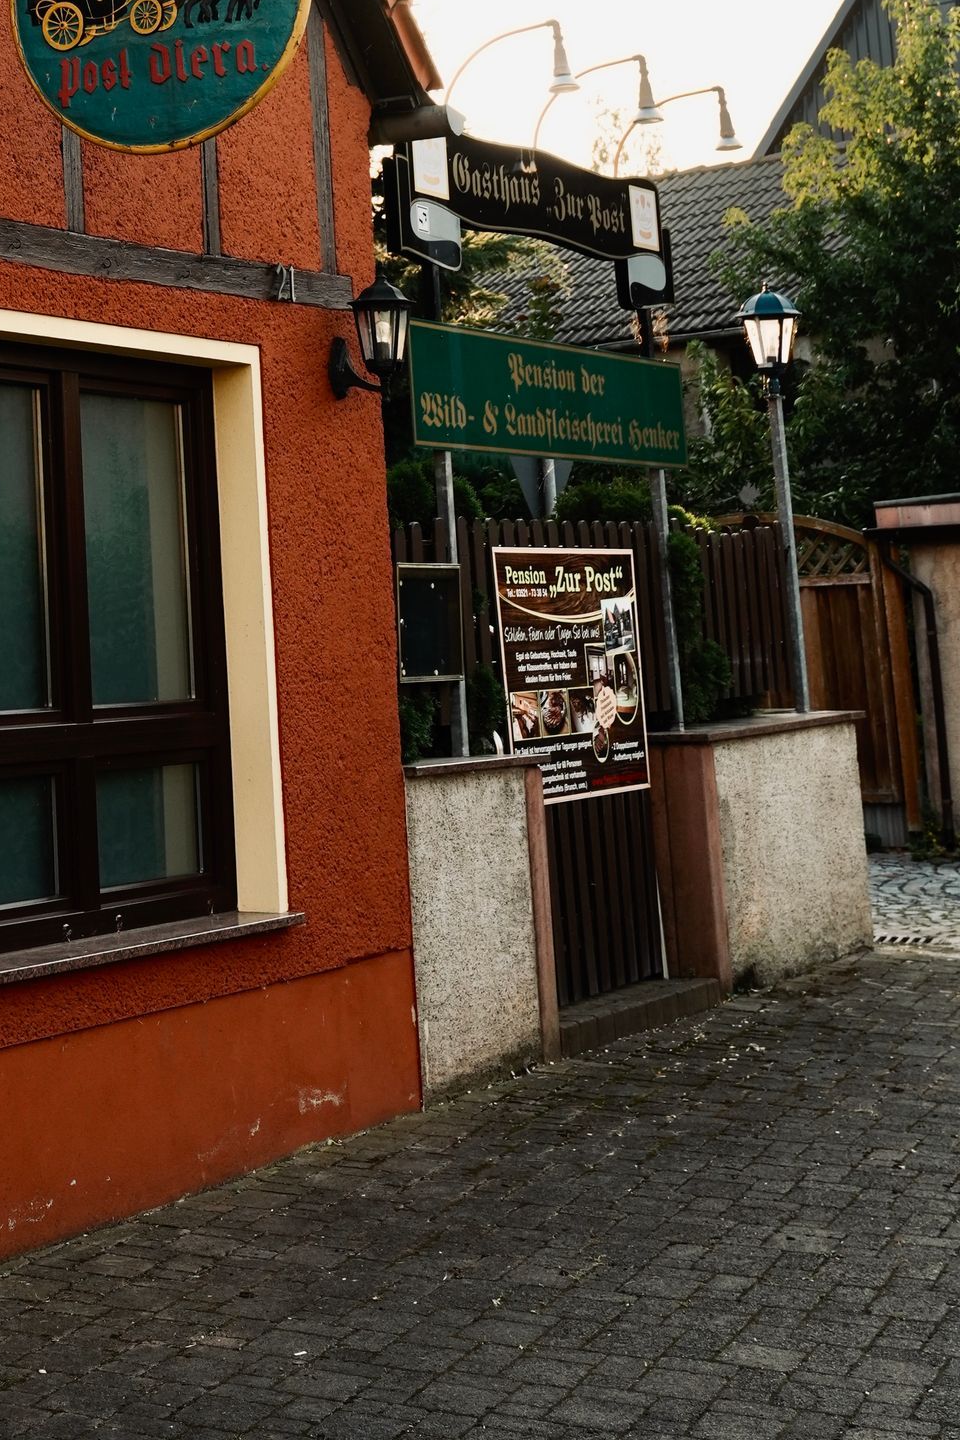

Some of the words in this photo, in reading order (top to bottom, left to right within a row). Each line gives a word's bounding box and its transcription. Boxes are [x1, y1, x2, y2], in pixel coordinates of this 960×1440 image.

[452, 152, 540, 213] Gasthaus
[276, 262, 297, 302] 21
[507, 352, 576, 393] Pension
[581, 364, 605, 397] der
[420, 391, 475, 429] Wild-
[483, 399, 499, 435] &
[504, 402, 623, 451] Landfleischerei
[628, 416, 680, 451] Henker
[504, 565, 547, 585] Pension
